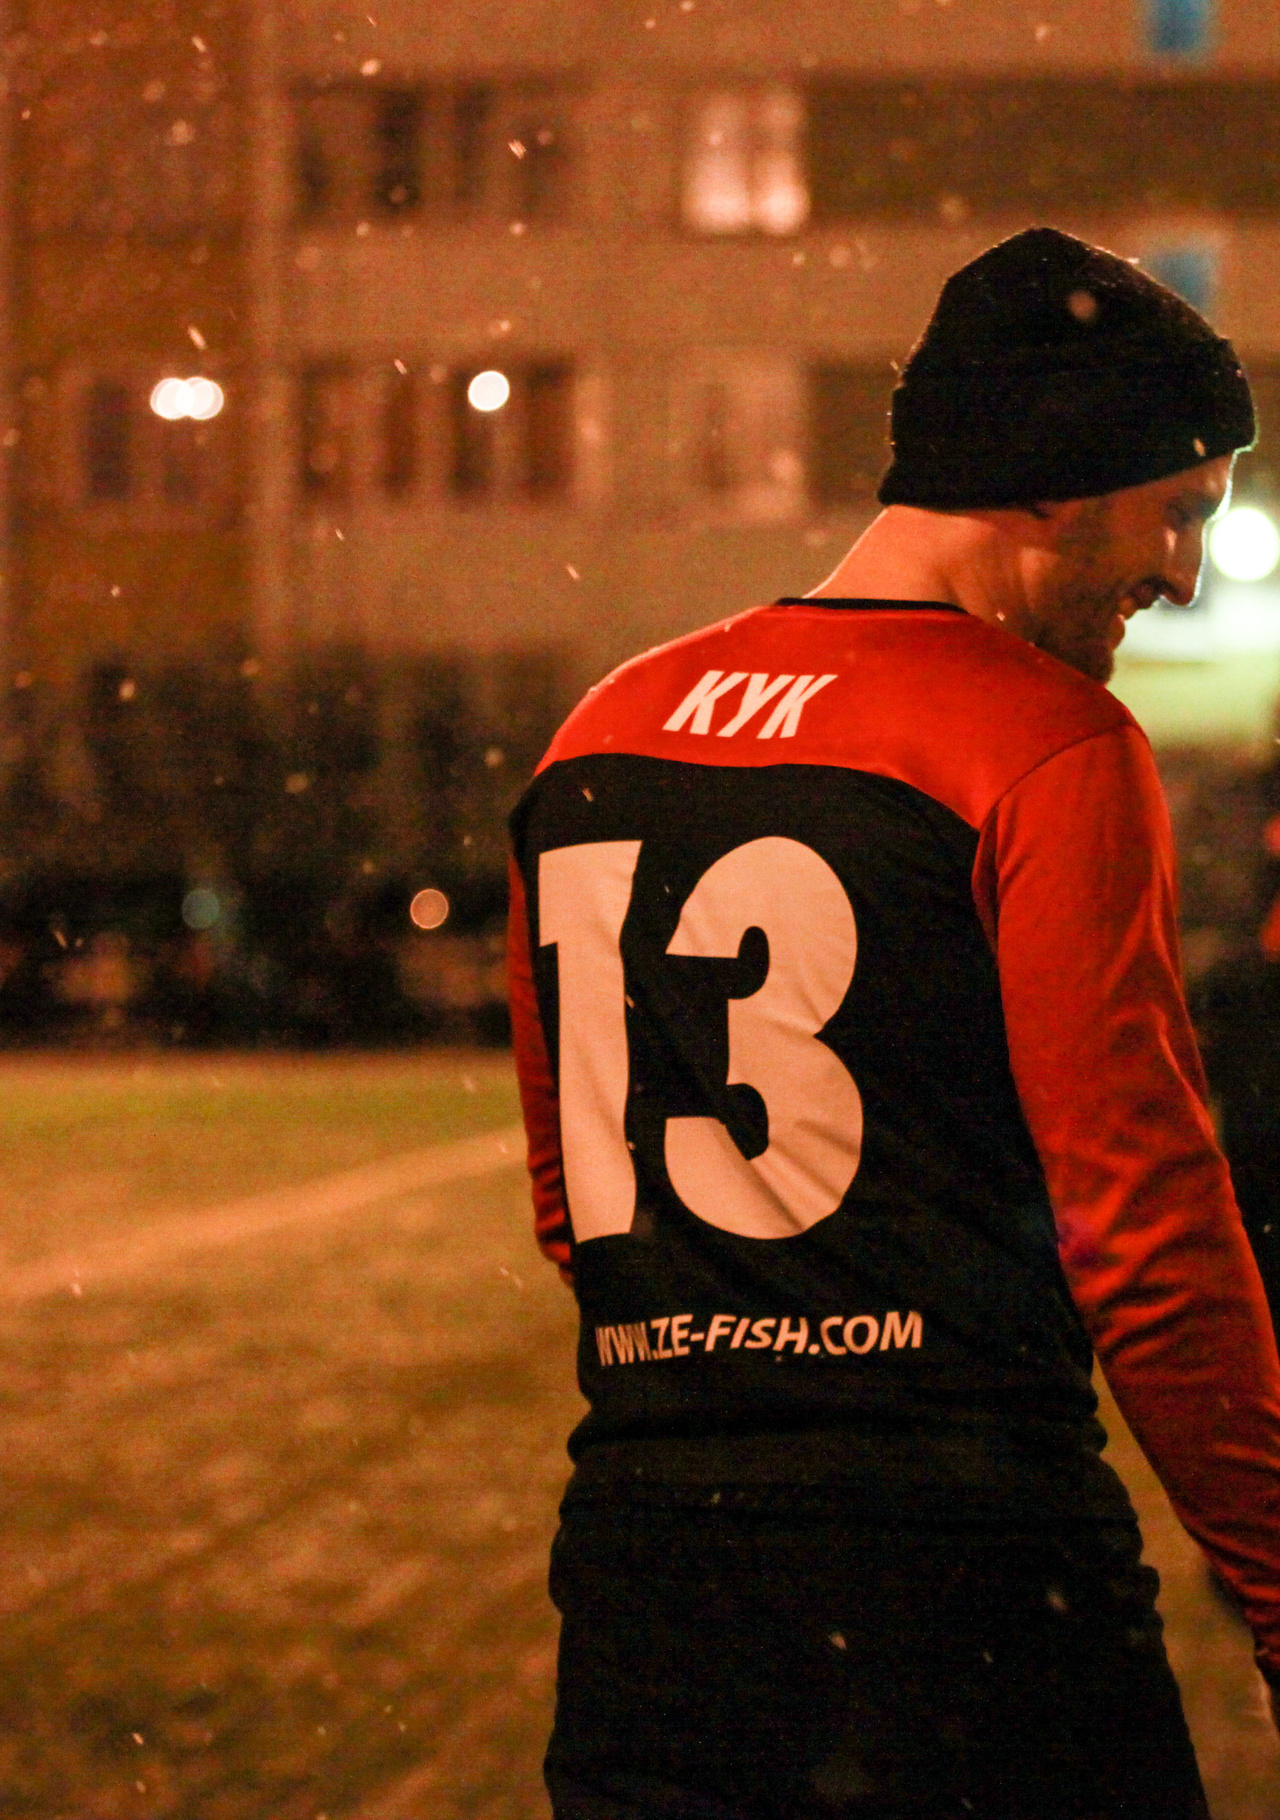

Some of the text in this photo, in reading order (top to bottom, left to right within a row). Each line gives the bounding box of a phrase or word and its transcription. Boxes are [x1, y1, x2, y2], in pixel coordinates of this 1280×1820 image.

[663, 670, 838, 739] KYK
[538, 836, 863, 1243] 13
[595, 1311, 923, 1367] WWW.ZE-FISH.COM
